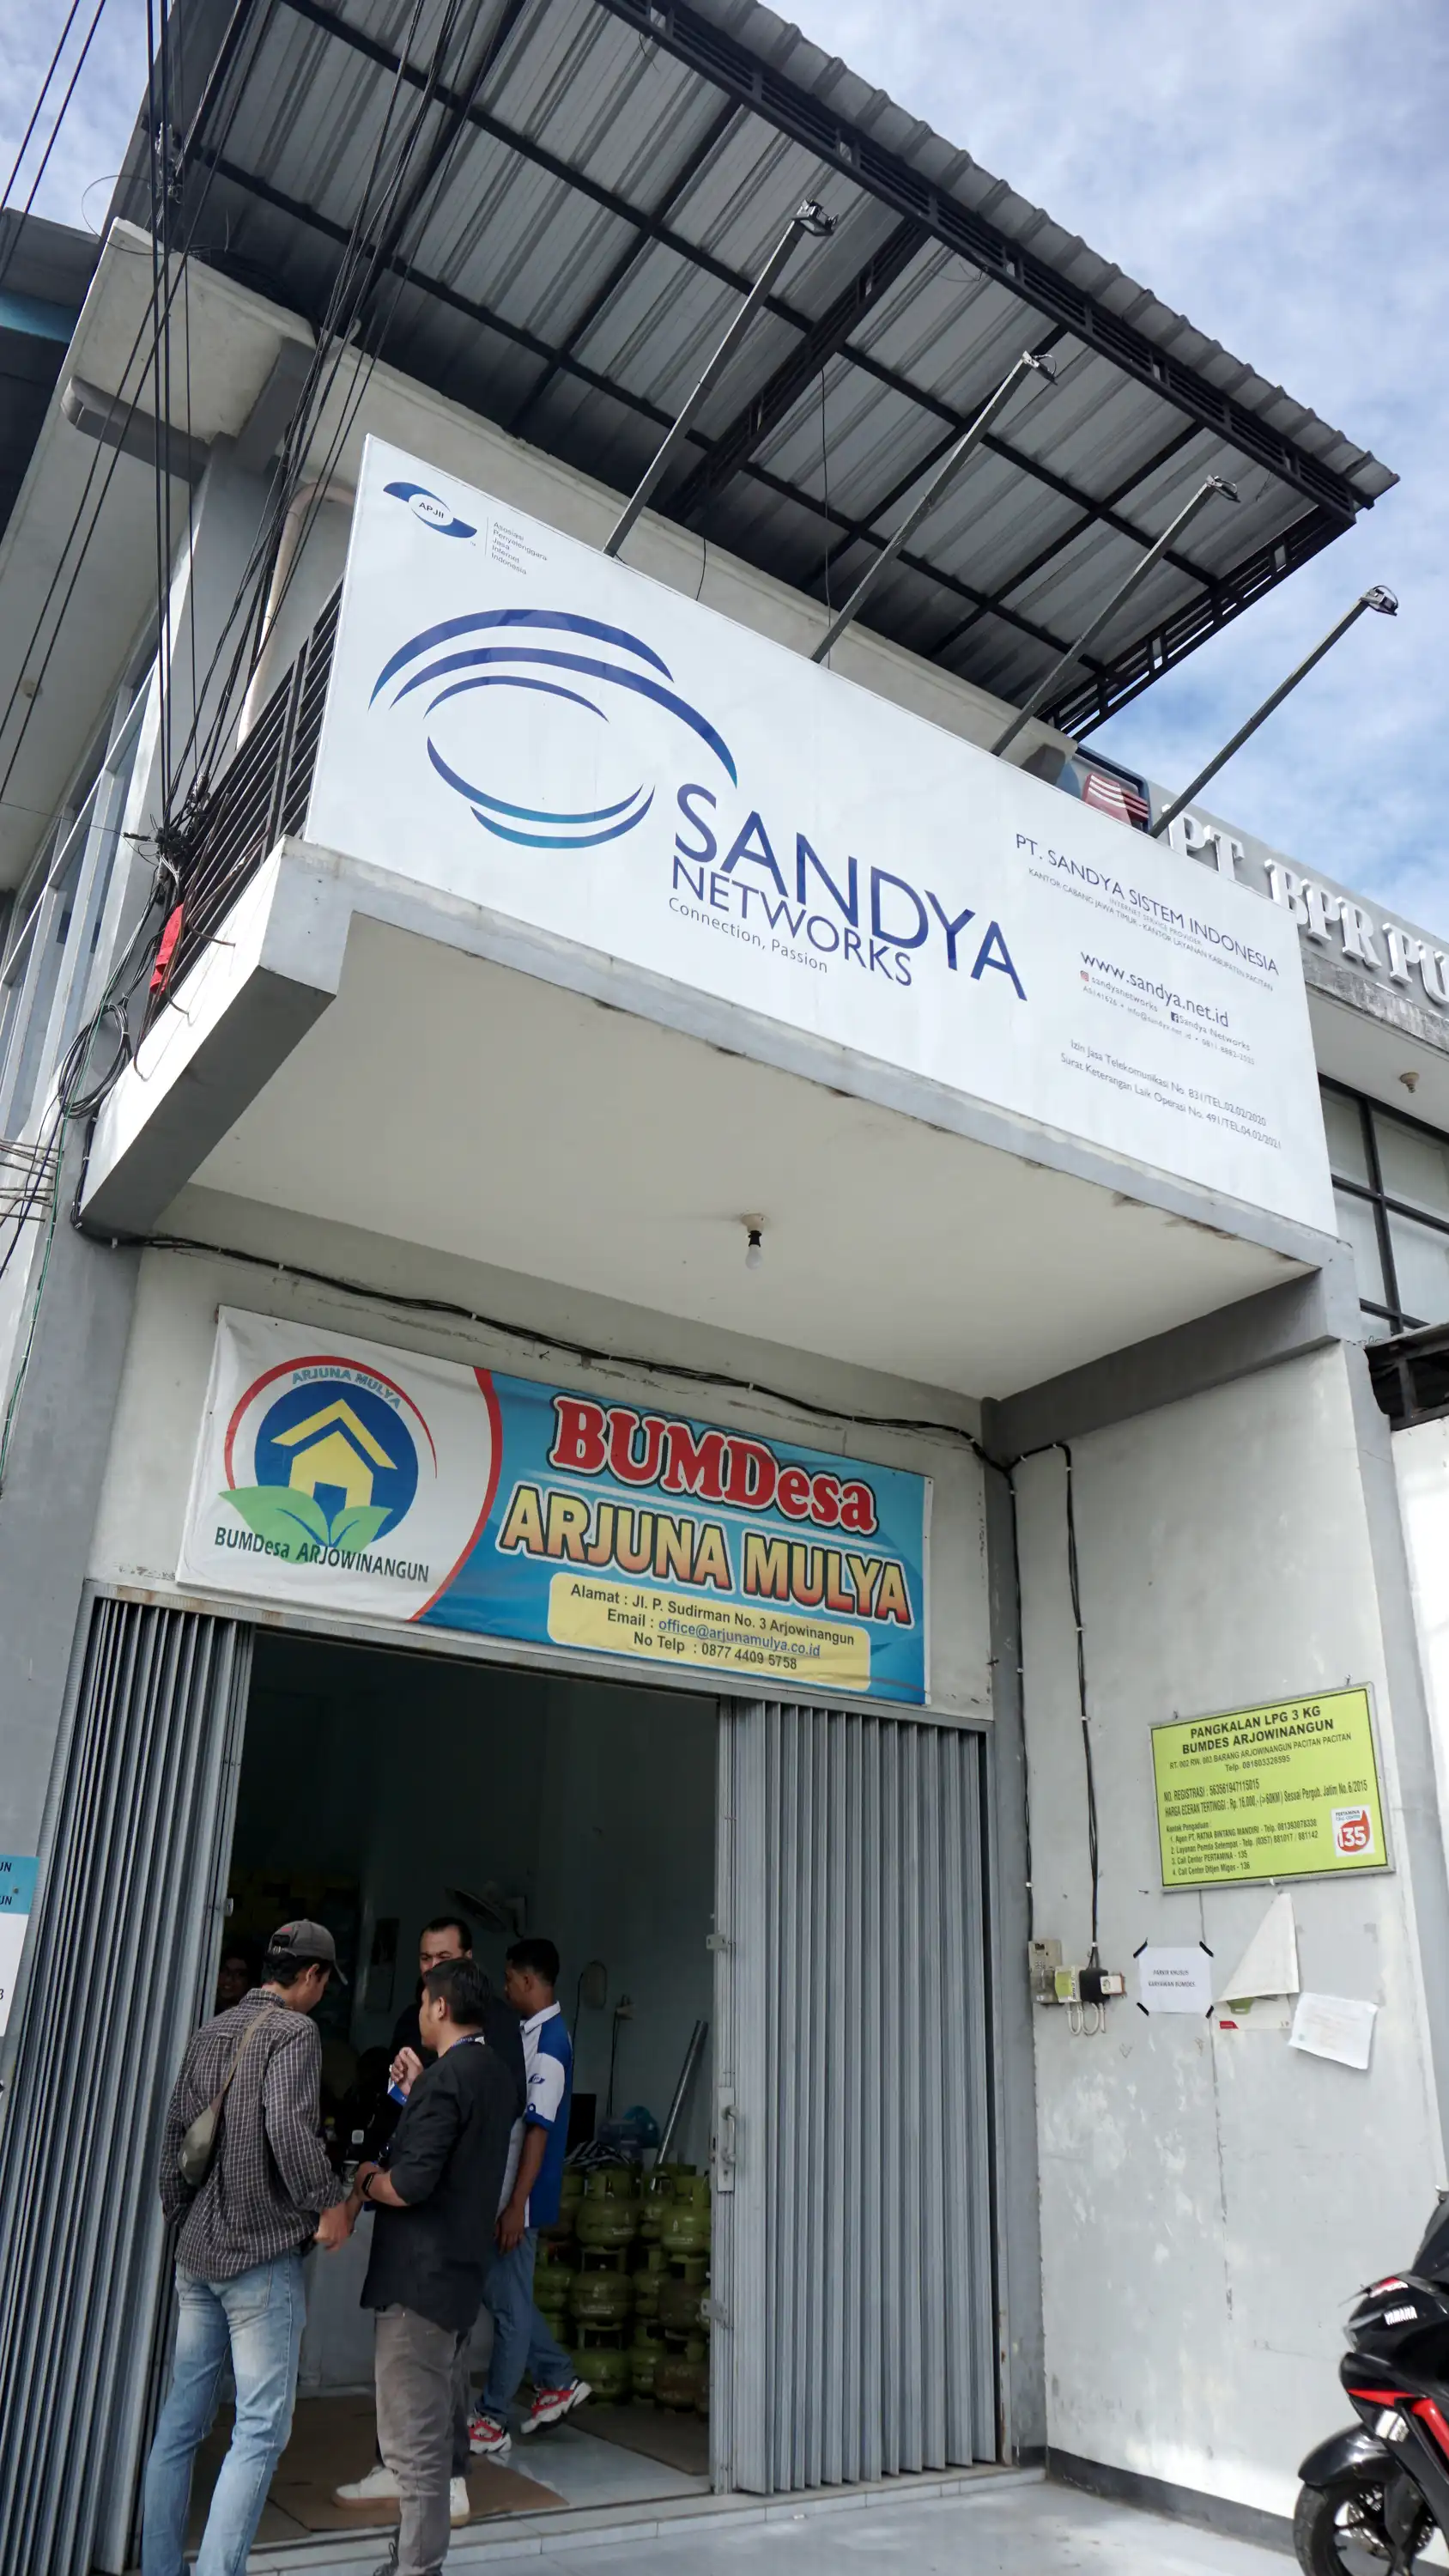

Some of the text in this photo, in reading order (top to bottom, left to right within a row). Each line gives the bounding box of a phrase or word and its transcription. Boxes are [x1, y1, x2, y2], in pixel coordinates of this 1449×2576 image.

[419, 501, 444, 519] APJII
[494, 521, 524, 541] Asosiasi
[491, 552, 527, 575] Indonesia
[492, 538, 510, 550] Jasa
[492, 544, 519, 563] Internet
[493, 529, 548, 561] Penyelenggara
[675, 783, 1028, 1001] SANDYA
[1016, 834, 1280, 975] PT. SANDYA SISTEM INDONESIA
[1028, 867, 1061, 889] KANTOR
[1063, 884, 1094, 904] CABANG
[1094, 900, 1114, 914] JAWA
[1116, 910, 1137, 925] TIMUR
[1143, 923, 1172, 943] KANTOR
[1161, 804, 1245, 880] PT
[1264, 859, 1382, 970] BPR
[670, 897, 828, 974] Connection, Passion
[673, 854, 912, 986] NETWORKS
[1081, 951, 1229, 1028] www.sandya.net.id
[1091, 976, 1251, 1052] sandyanetworks Sandya Networks
[1061, 1052, 1083, 1071] Surat
[1085, 1063, 1132, 1091] Keterangan
[1135, 1084, 1151, 1098] Laik
[1154, 1092, 1186, 1112] Operasi
[1189, 1106, 1203, 1120] No.
[1087, 1046, 1103, 1061] Jasa
[1105, 1054, 1168, 1089] Telekomunikasi
[291, 1365, 402, 1409] ARJUNA MULYA
[549, 1394, 878, 1536] BUMDesa
[215, 1526, 429, 1583] BUMDesa ARJOWINANGUN
[498, 1485, 914, 1626] ARJUNA MULYA
[571, 1583, 620, 1605] Alamat
[652, 1599, 664, 1612] P.
[668, 1601, 731, 1624] Sudirman
[734, 1613, 755, 1630] No.
[759, 1617, 767, 1630] 3
[769, 1619, 855, 1647] Arjowinangun
[607, 1608, 646, 1627] Email
[658, 1618, 822, 1657] office@arjunamulya.co.id
[634, 1631, 652, 1647] No
[658, 1635, 685, 1654] Telp
[701, 1643, 731, 1660] 0877
[734, 1648, 764, 1664] 4409
[768, 1653, 797, 1670] 5758
[1182, 1718, 1334, 1754] BUMDES ARJOWINANGUN
[1191, 1705, 1321, 1739] PANGKALAN LPG 3 KG
[1213, 1751, 1240, 1763] BARANG
[1240, 1742, 1292, 1758] ARJOWINANGUN
[1294, 1736, 1321, 1749] PACITAN
[1322, 1732, 1352, 1746] PACITAN
[1173, 1786, 1205, 1801] REGISTRASI
[1284, 1789, 1301, 1802] Sesuai
[1323, 1784, 1337, 1796] Jatim
[1177, 1856, 1187, 1865] Call
[1203, 1852, 1234, 1862] PERTAMINA
[1238, 1850, 1248, 1859] 135
[1339, 1826, 1367, 1848] 135
[1384, 2306, 1418, 2325] YAMAHA
